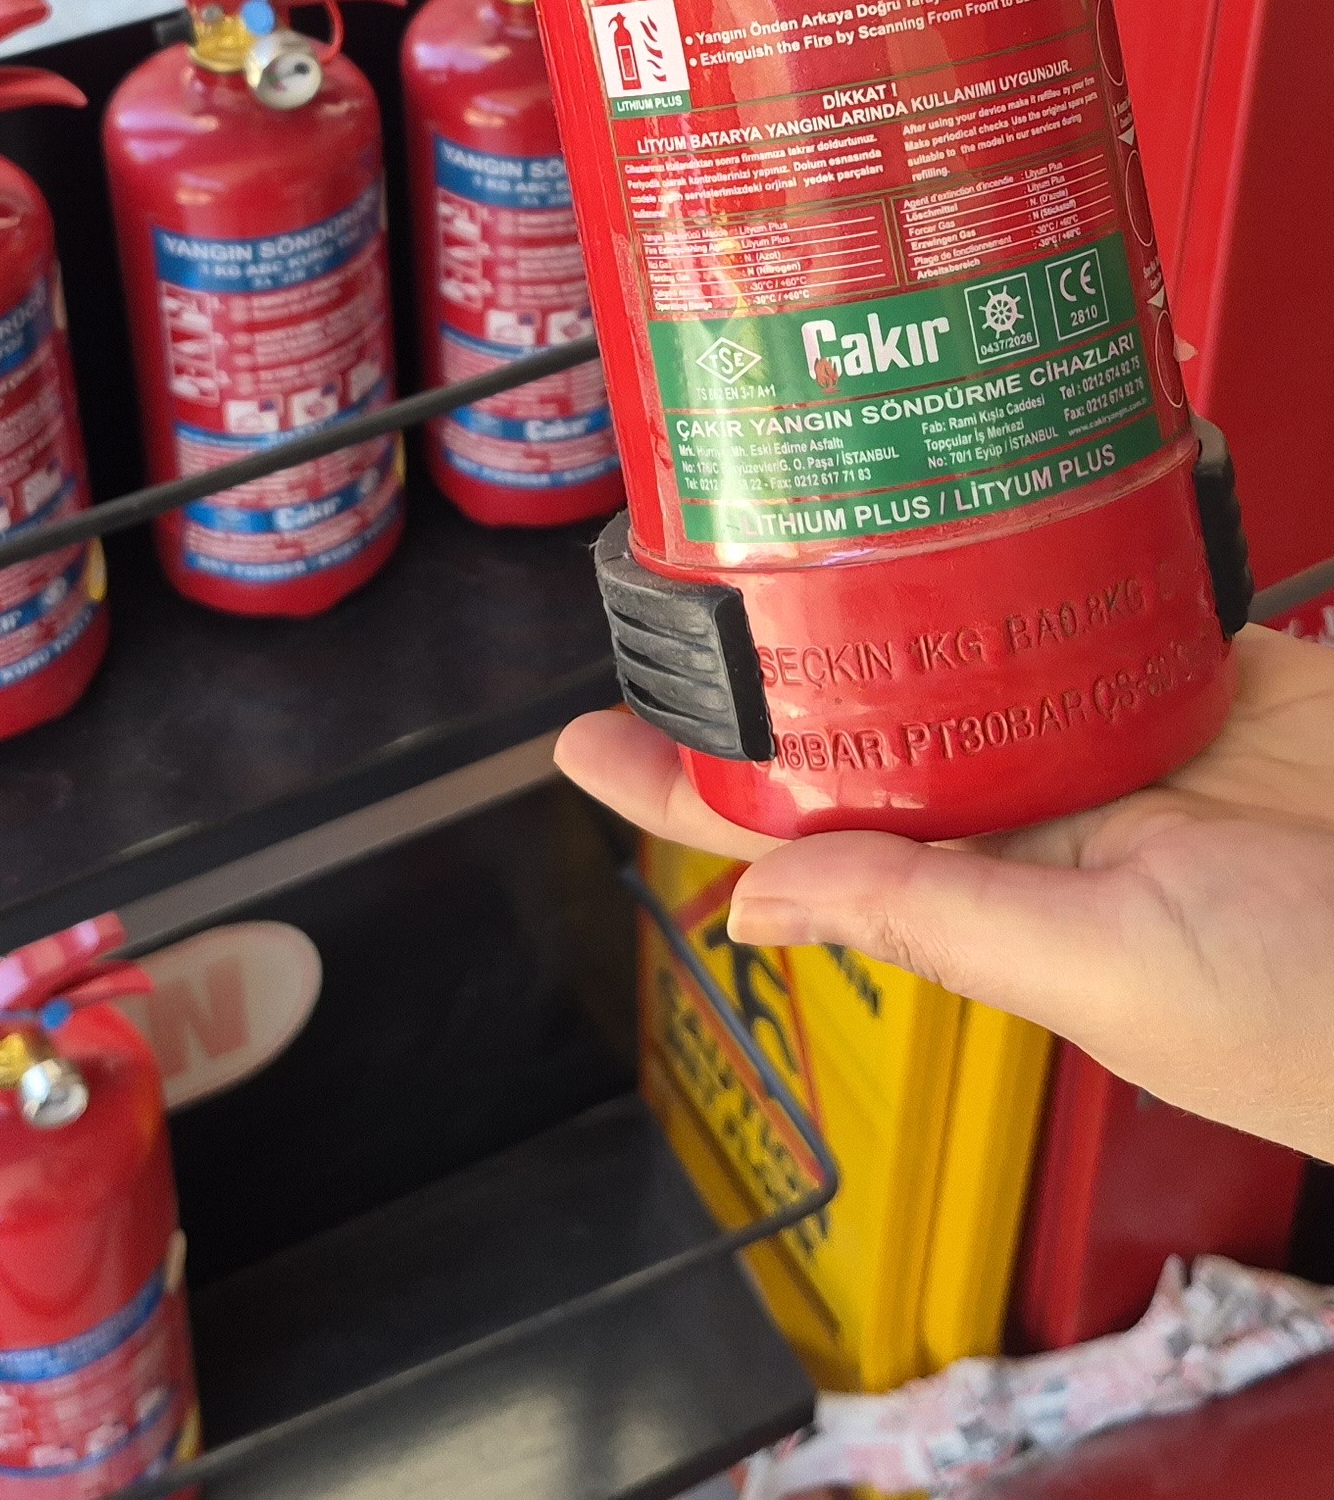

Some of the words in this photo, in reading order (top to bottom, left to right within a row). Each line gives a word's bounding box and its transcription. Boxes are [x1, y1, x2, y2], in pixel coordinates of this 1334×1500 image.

[700, 43, 774, 66] Extinguish
[777, 39, 801, 53] the
[803, 34, 833, 48] Fire
[836, 30, 855, 45] by
[858, 17, 925, 39] Scanning
[927, 7, 963, 25] From
[966, 0, 999, 17] Front
[750, 19, 798, 36] Önden
[801, 9, 853, 28] Arkaya
[856, 0, 901, 18] Doğru
[617, 98, 653, 113] LITHIUM
[654, 94, 683, 109] PLUS
[636, 134, 686, 154] LİTYUM
[690, 126, 763, 149] BATARYA
[764, 101, 908, 139] YANGINLARINDA
[911, 81, 997, 113] KULLANIMI
[999, 59, 1072, 91] UYGUNDUR.
[822, 84, 886, 111] DİKKAT
[902, 123, 926, 136] After
[928, 116, 954, 132] using
[955, 112, 976, 129] your
[978, 103, 1007, 118] device
[932, 127, 977, 148] periodical
[979, 120, 1009, 135] checks
[1070, 305, 1098, 327] 2810
[708, 346, 744, 375] TSE
[676, 420, 744, 441] ÇAKIR
[750, 409, 853, 436] YANGIN
[861, 373, 1024, 426] SÖNDÜRME
[1029, 332, 1135, 387] CİHAZLARI
[922, 420, 946, 435] Fab:
[949, 412, 977, 426] Rami
[1006, 395, 1045, 414] Caddesi
[924, 432, 972, 453] Topçular
[987, 417, 1024, 439] Merkezi
[742, 510, 847, 537] LITHIUM
[855, 495, 932, 529] PLUS
[954, 466, 1054, 512] LİTYUM
[1061, 443, 1116, 484] PLUS
[793, 473, 820, 488] 0212
